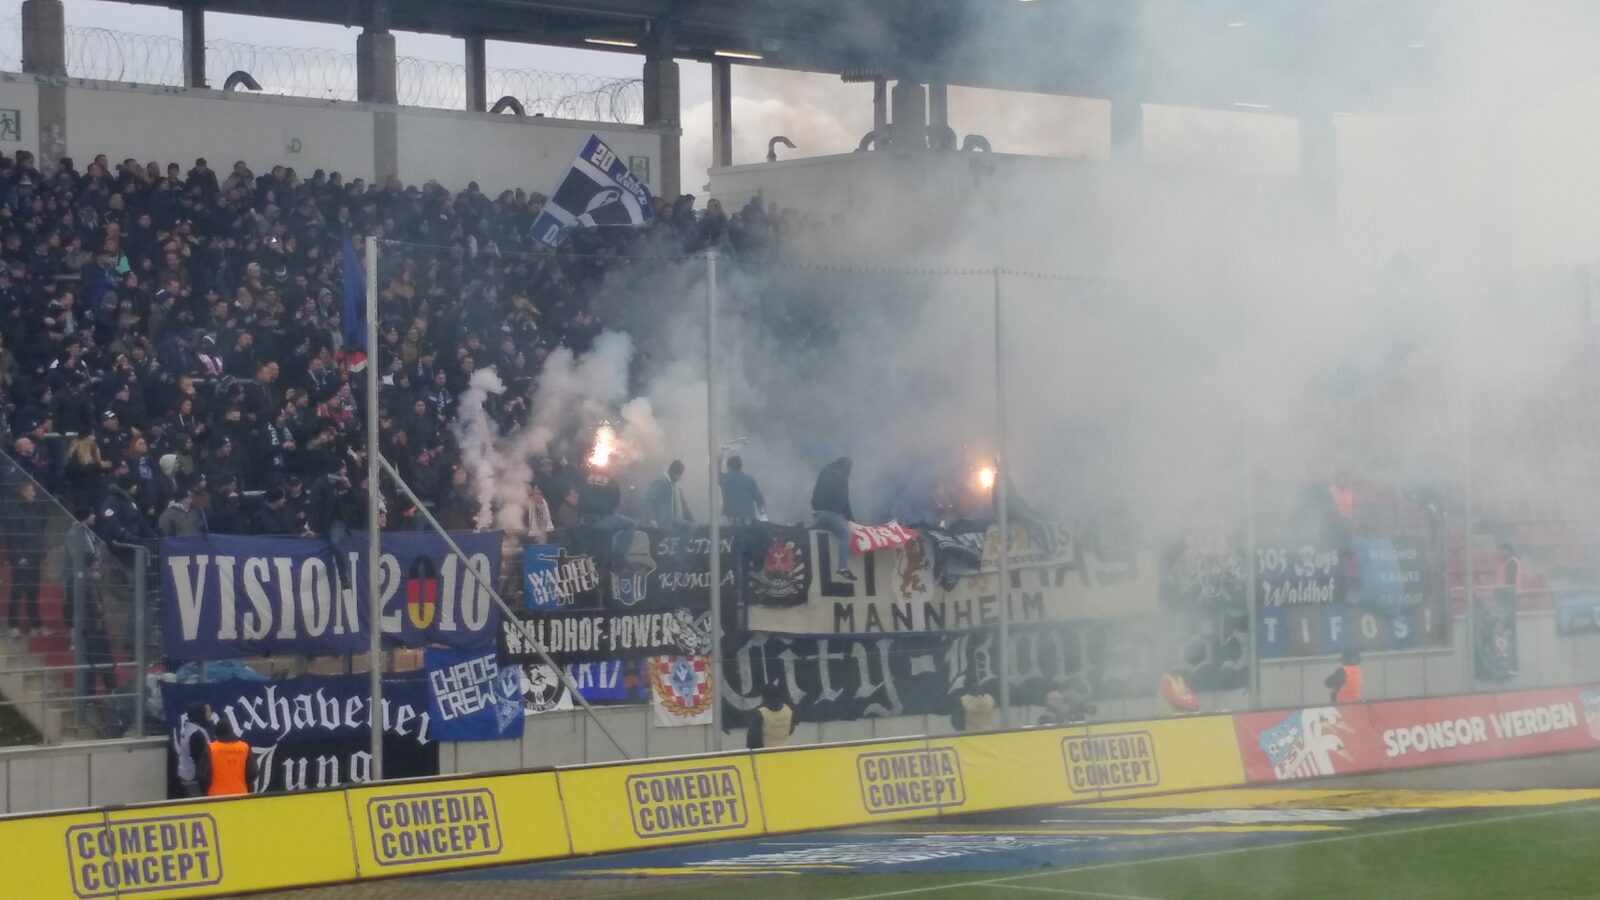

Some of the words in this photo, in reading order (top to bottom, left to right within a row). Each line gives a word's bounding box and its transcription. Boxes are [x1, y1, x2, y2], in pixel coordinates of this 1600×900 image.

[590, 143, 616, 172] 20
[168, 551, 360, 641] VISION
[379, 552, 492, 634] 2010
[1262, 577, 1335, 607] Waldhof
[833, 592, 1046, 633] MANNHEIM
[1263, 608, 1432, 643] TIFOSI
[503, 612, 678, 654] WALDHOF-POWER
[430, 653, 498, 696] CHAOS
[436, 681, 498, 721] CREW
[1383, 716, 1488, 757] SPONSOR
[1490, 702, 1578, 739] WERDEN
[864, 753, 954, 782] COMEDIA
[1068, 737, 1148, 763] COMEDIA
[634, 772, 736, 804] COMEDIA
[1073, 760, 1152, 788] CONCEPT
[869, 778, 957, 808] CONCEPT
[376, 795, 489, 829] COMEDIA
[639, 798, 738, 831] CONCEPT
[76, 821, 209, 859] COMEDIA
[381, 823, 491, 859] CONCEPT
[81, 851, 210, 890] CONCEPT
